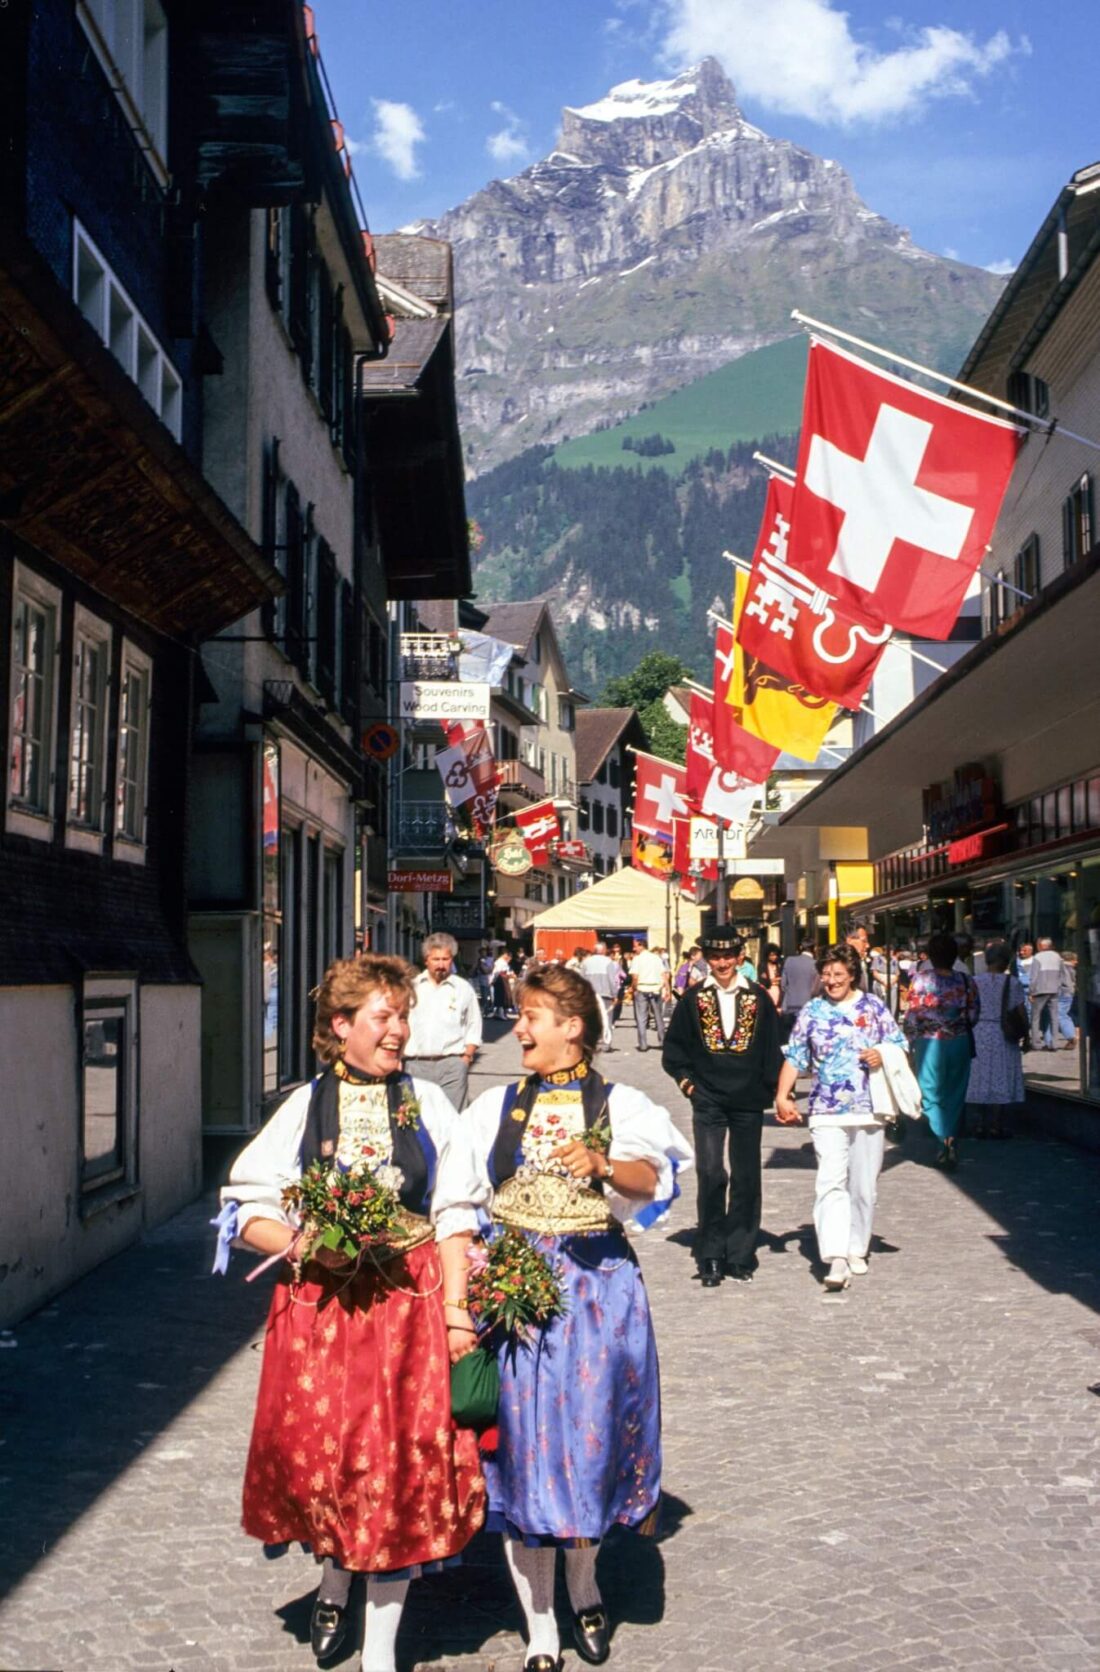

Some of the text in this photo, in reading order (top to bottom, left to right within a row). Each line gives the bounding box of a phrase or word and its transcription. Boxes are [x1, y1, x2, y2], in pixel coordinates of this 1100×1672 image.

[414, 686, 474, 697] Souvenirs
[403, 701, 487, 714] Wood Carving
